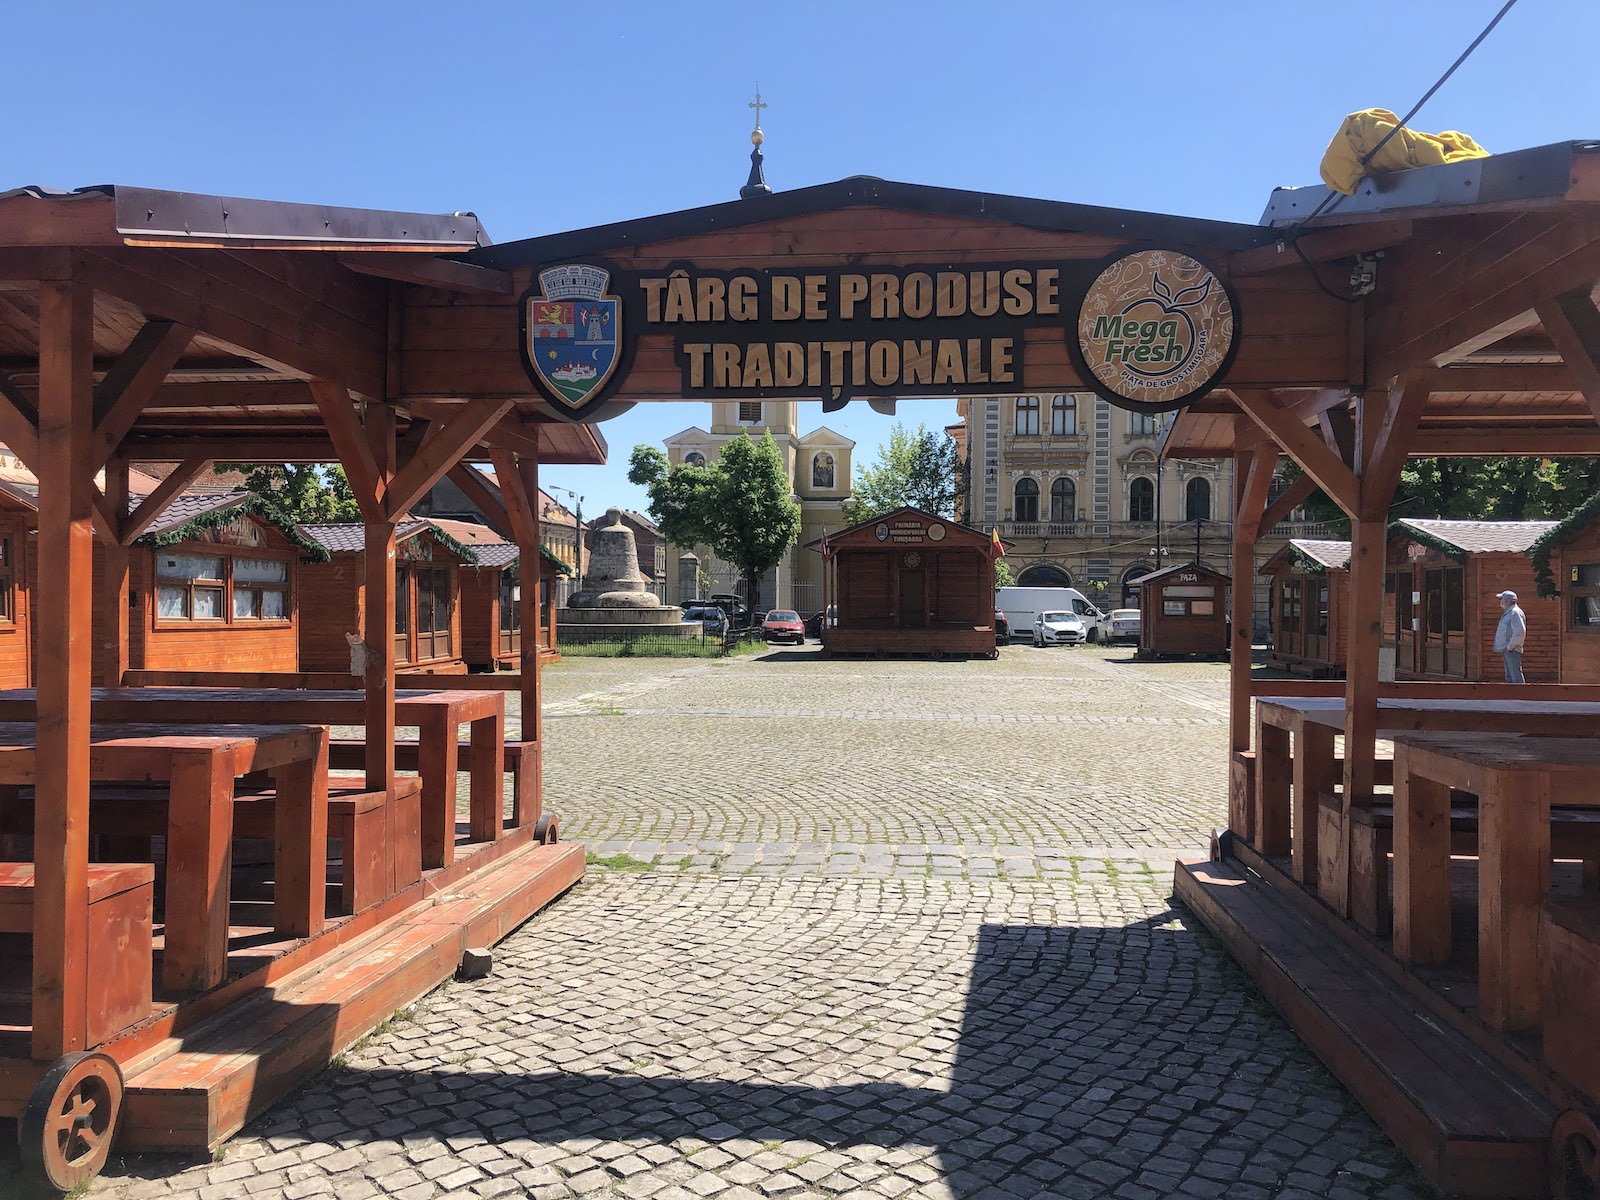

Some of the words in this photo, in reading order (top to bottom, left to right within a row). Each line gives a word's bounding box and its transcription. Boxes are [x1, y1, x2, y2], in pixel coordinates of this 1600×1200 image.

[640, 269, 759, 322] TÂRG
[771, 275, 828, 321] DE
[839, 269, 1060, 319] PRODUSE
[1093, 316, 1178, 344] Mega
[1105, 338, 1183, 362] Fresh
[683, 337, 1014, 400] TRADIȚIONALE
[1146, 380, 1158, 388] DE
[1160, 373, 1184, 387] GROS
[1180, 573, 1198, 582] PAZA
